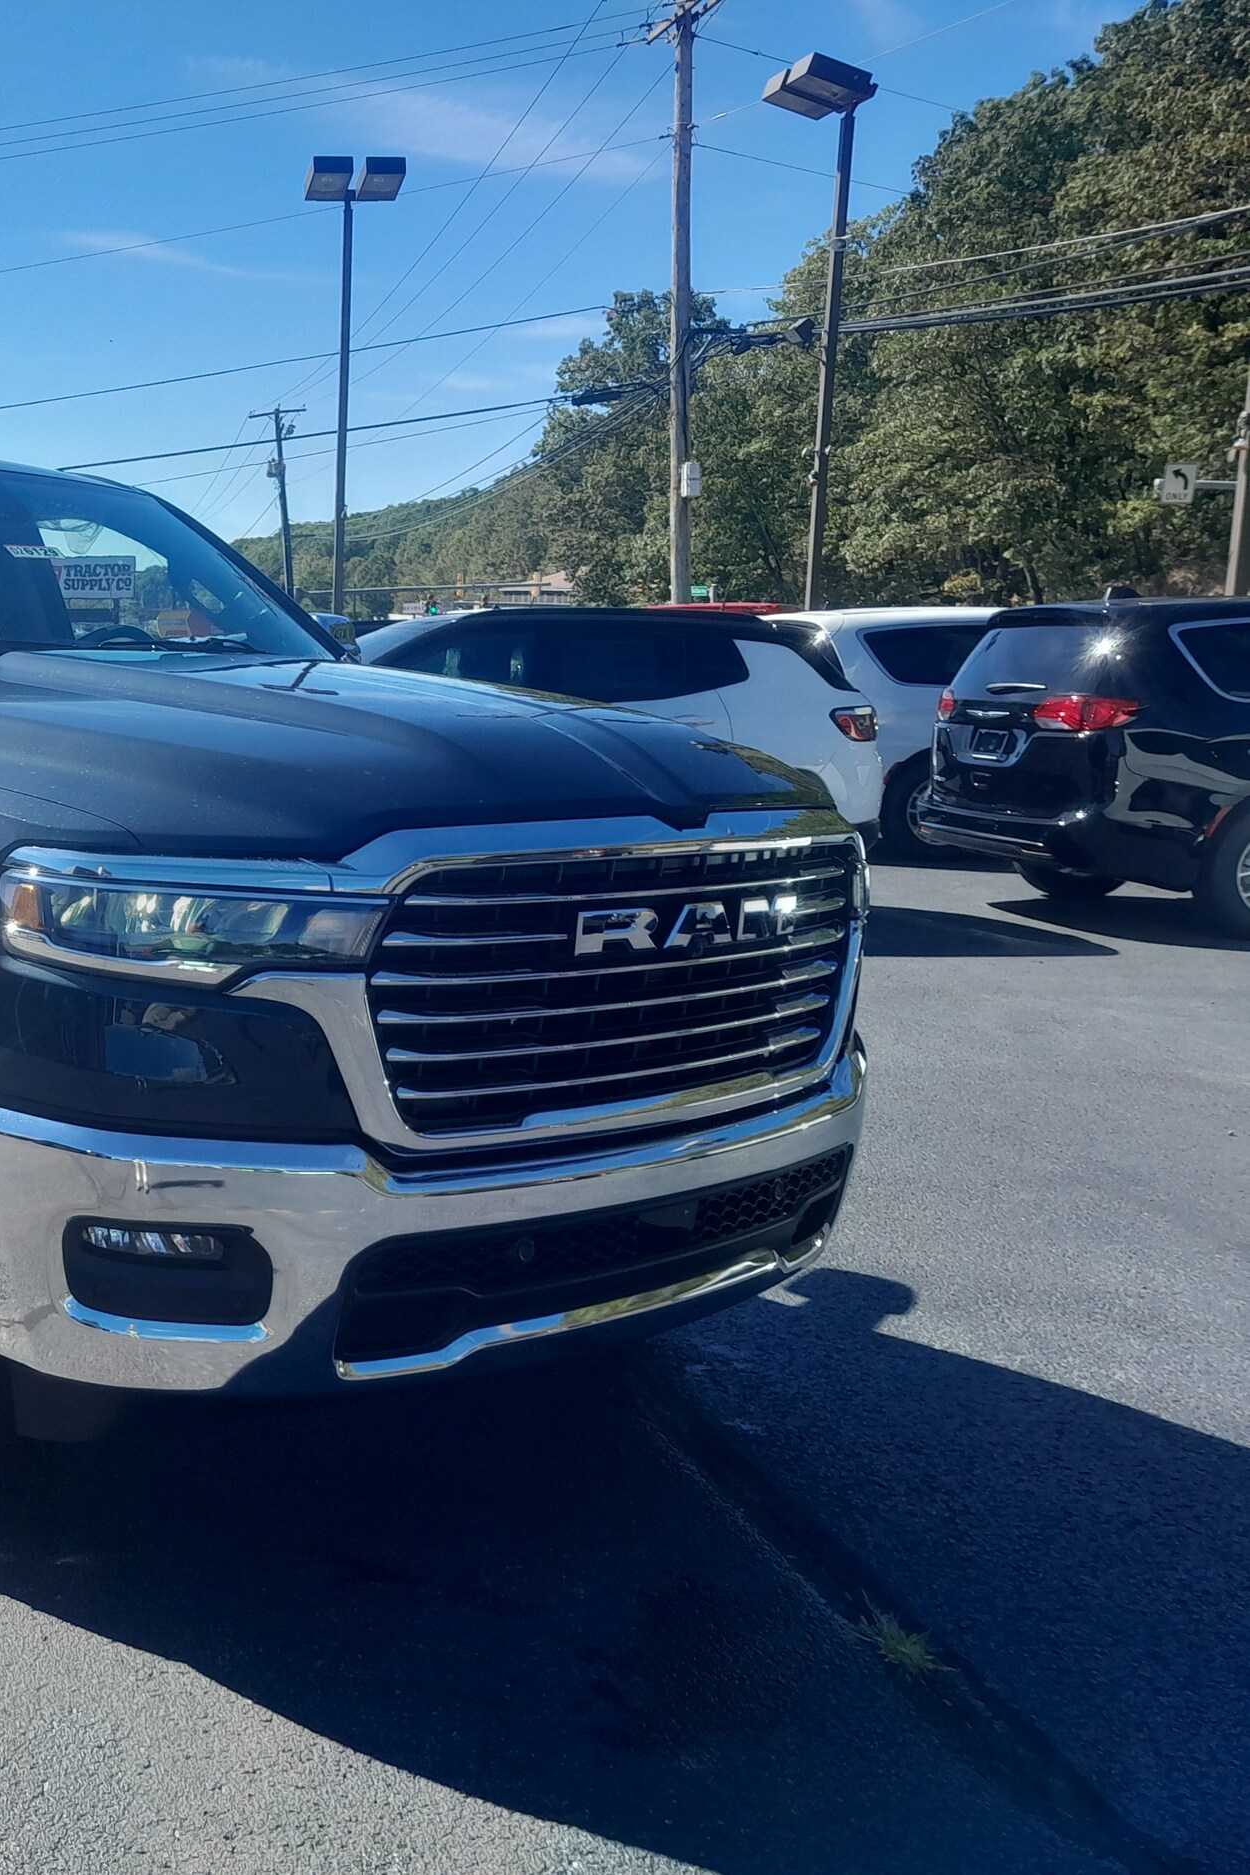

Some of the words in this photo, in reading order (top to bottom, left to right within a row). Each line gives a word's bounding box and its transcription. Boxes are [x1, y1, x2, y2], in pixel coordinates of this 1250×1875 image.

[64, 564, 132, 577] TRACTOR
[64, 578, 114, 591] SUPPLY
[575, 895, 797, 956] RAM
